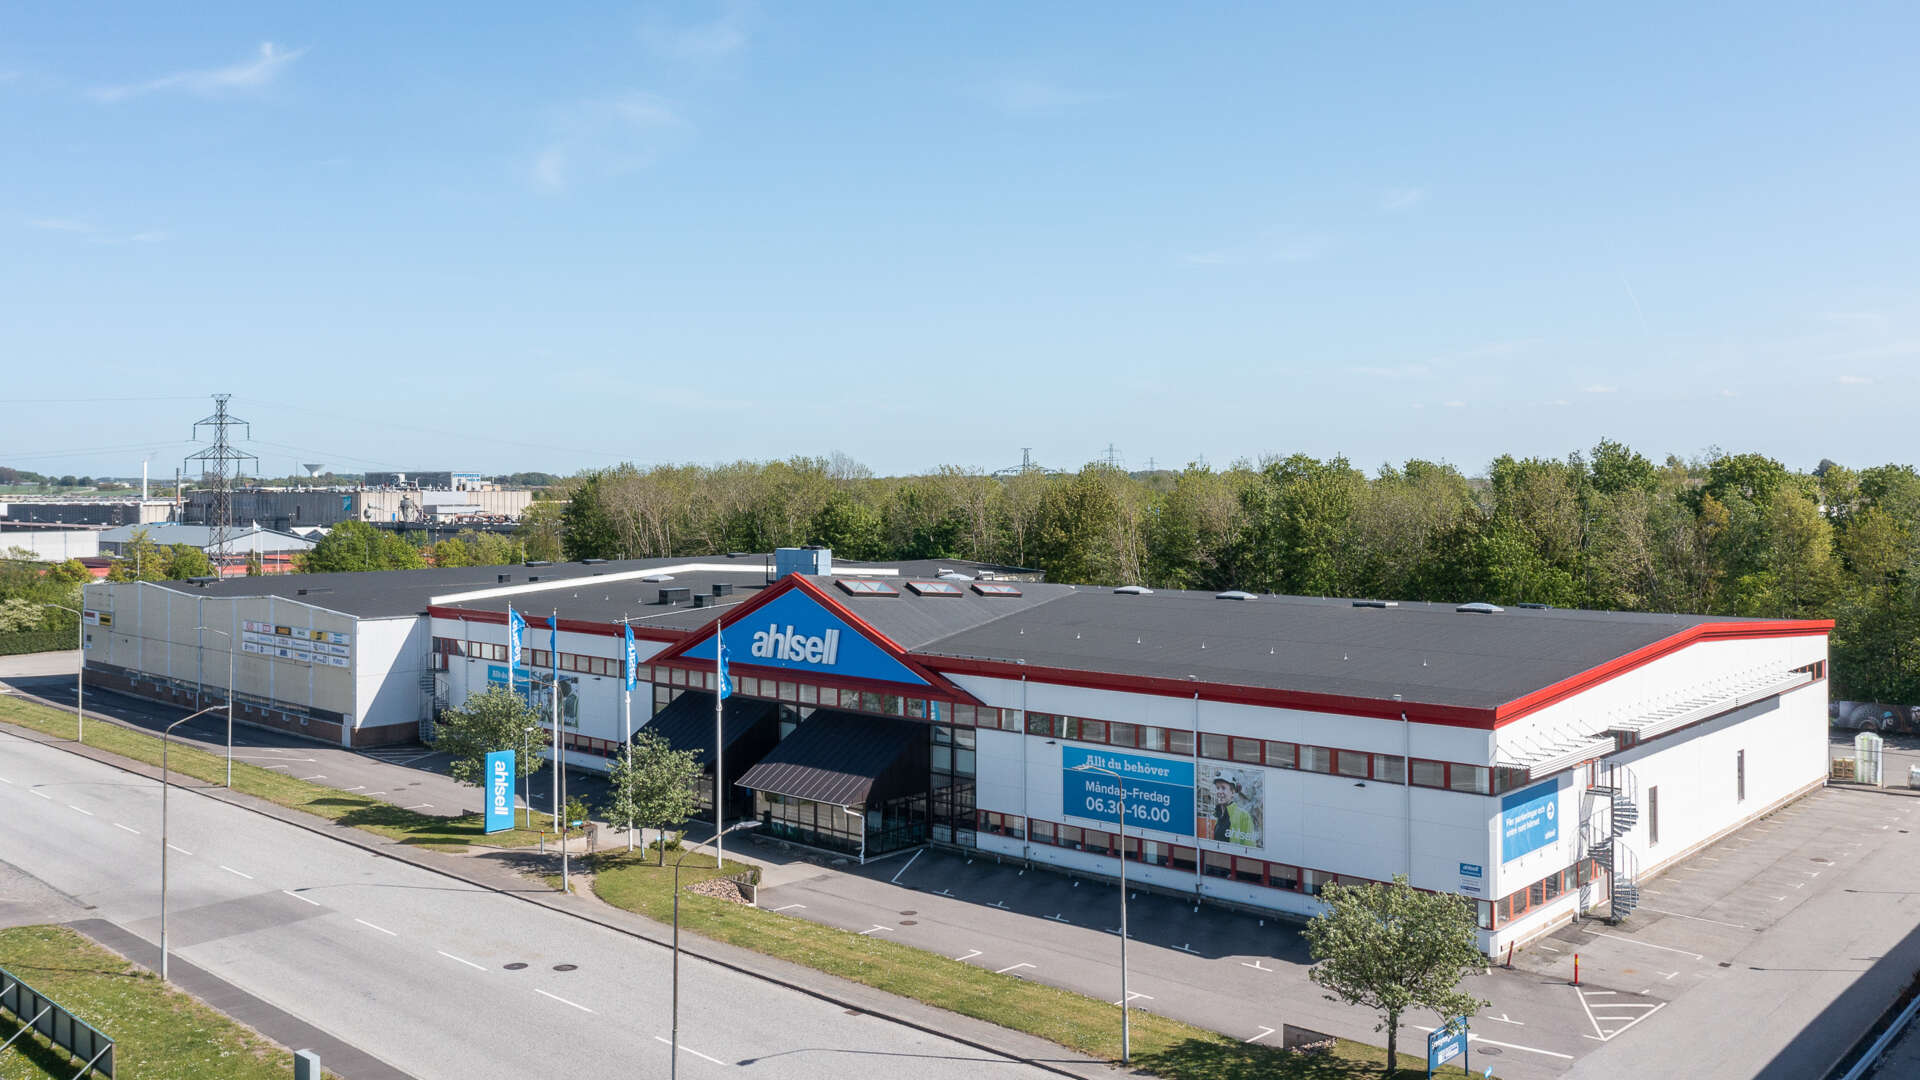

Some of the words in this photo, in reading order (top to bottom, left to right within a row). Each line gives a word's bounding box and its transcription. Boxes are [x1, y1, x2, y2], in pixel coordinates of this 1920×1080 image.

[752, 624, 839, 664] ahlsell
[1085, 755, 1107, 769] Allt
[1108, 758, 1123, 771] du
[1124, 760, 1170, 777] behöver
[494, 761, 509, 815] ahlsell
